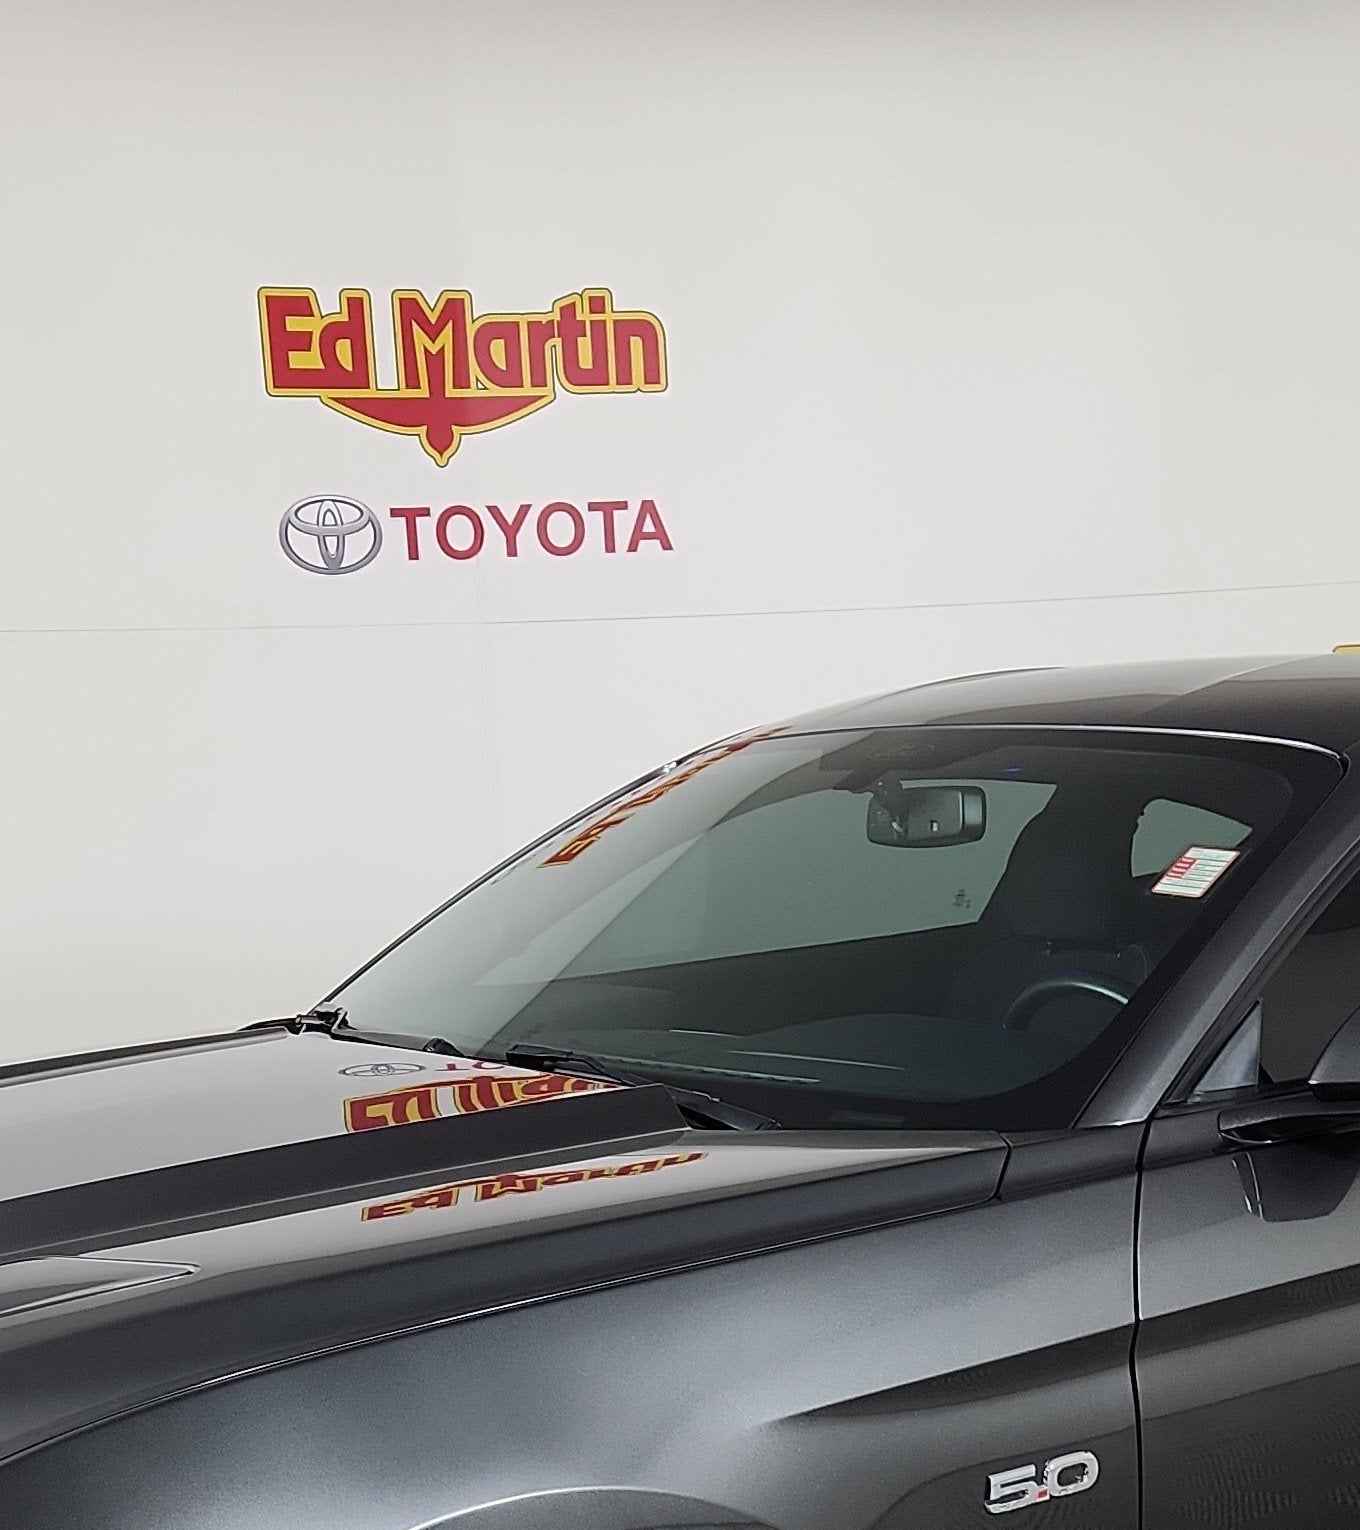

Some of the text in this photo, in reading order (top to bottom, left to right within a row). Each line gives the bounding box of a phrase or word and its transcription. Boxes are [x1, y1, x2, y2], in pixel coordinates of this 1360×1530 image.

[264, 293, 661, 391] Ed Martin
[389, 499, 674, 561] TOYOTA
[984, 1450, 1099, 1514] 5.0
